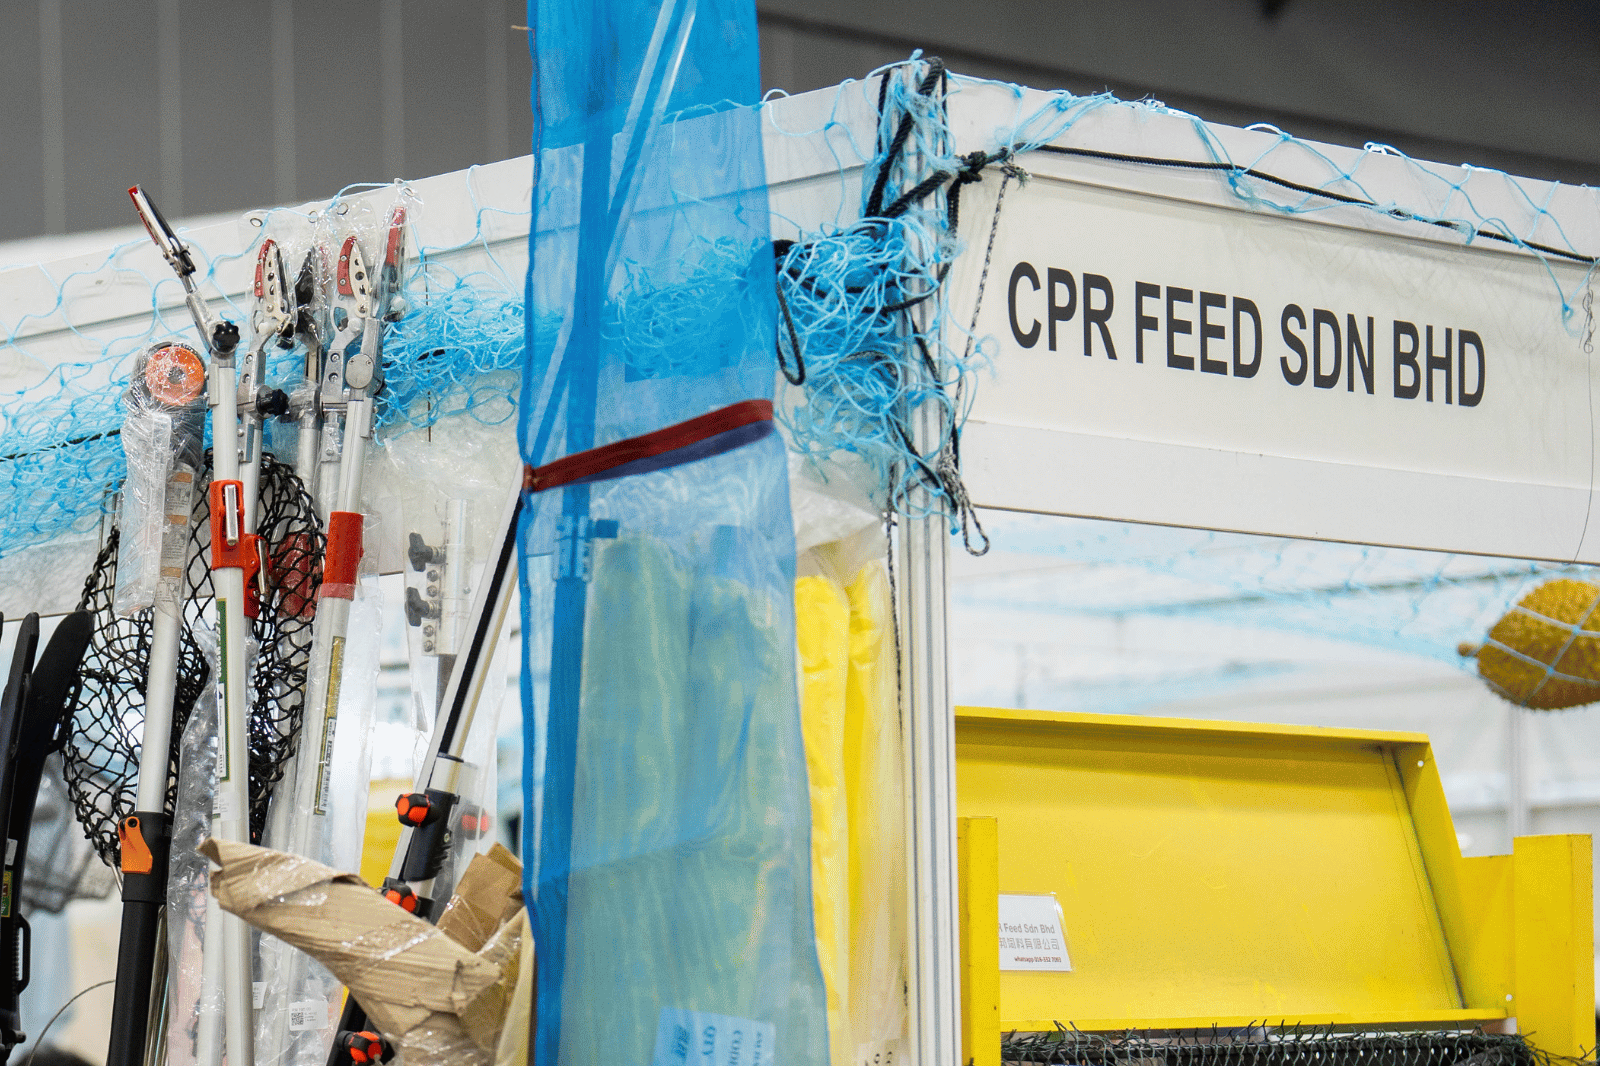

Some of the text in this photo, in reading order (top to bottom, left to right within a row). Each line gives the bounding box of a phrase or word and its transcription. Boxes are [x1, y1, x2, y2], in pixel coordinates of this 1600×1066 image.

[1007, 261, 1486, 408] CPR FEED SDN BHD
[1004, 923, 1023, 933] Feed
[1024, 923, 1039, 934] Sdn
[1040, 924, 1055, 934] Bhd
